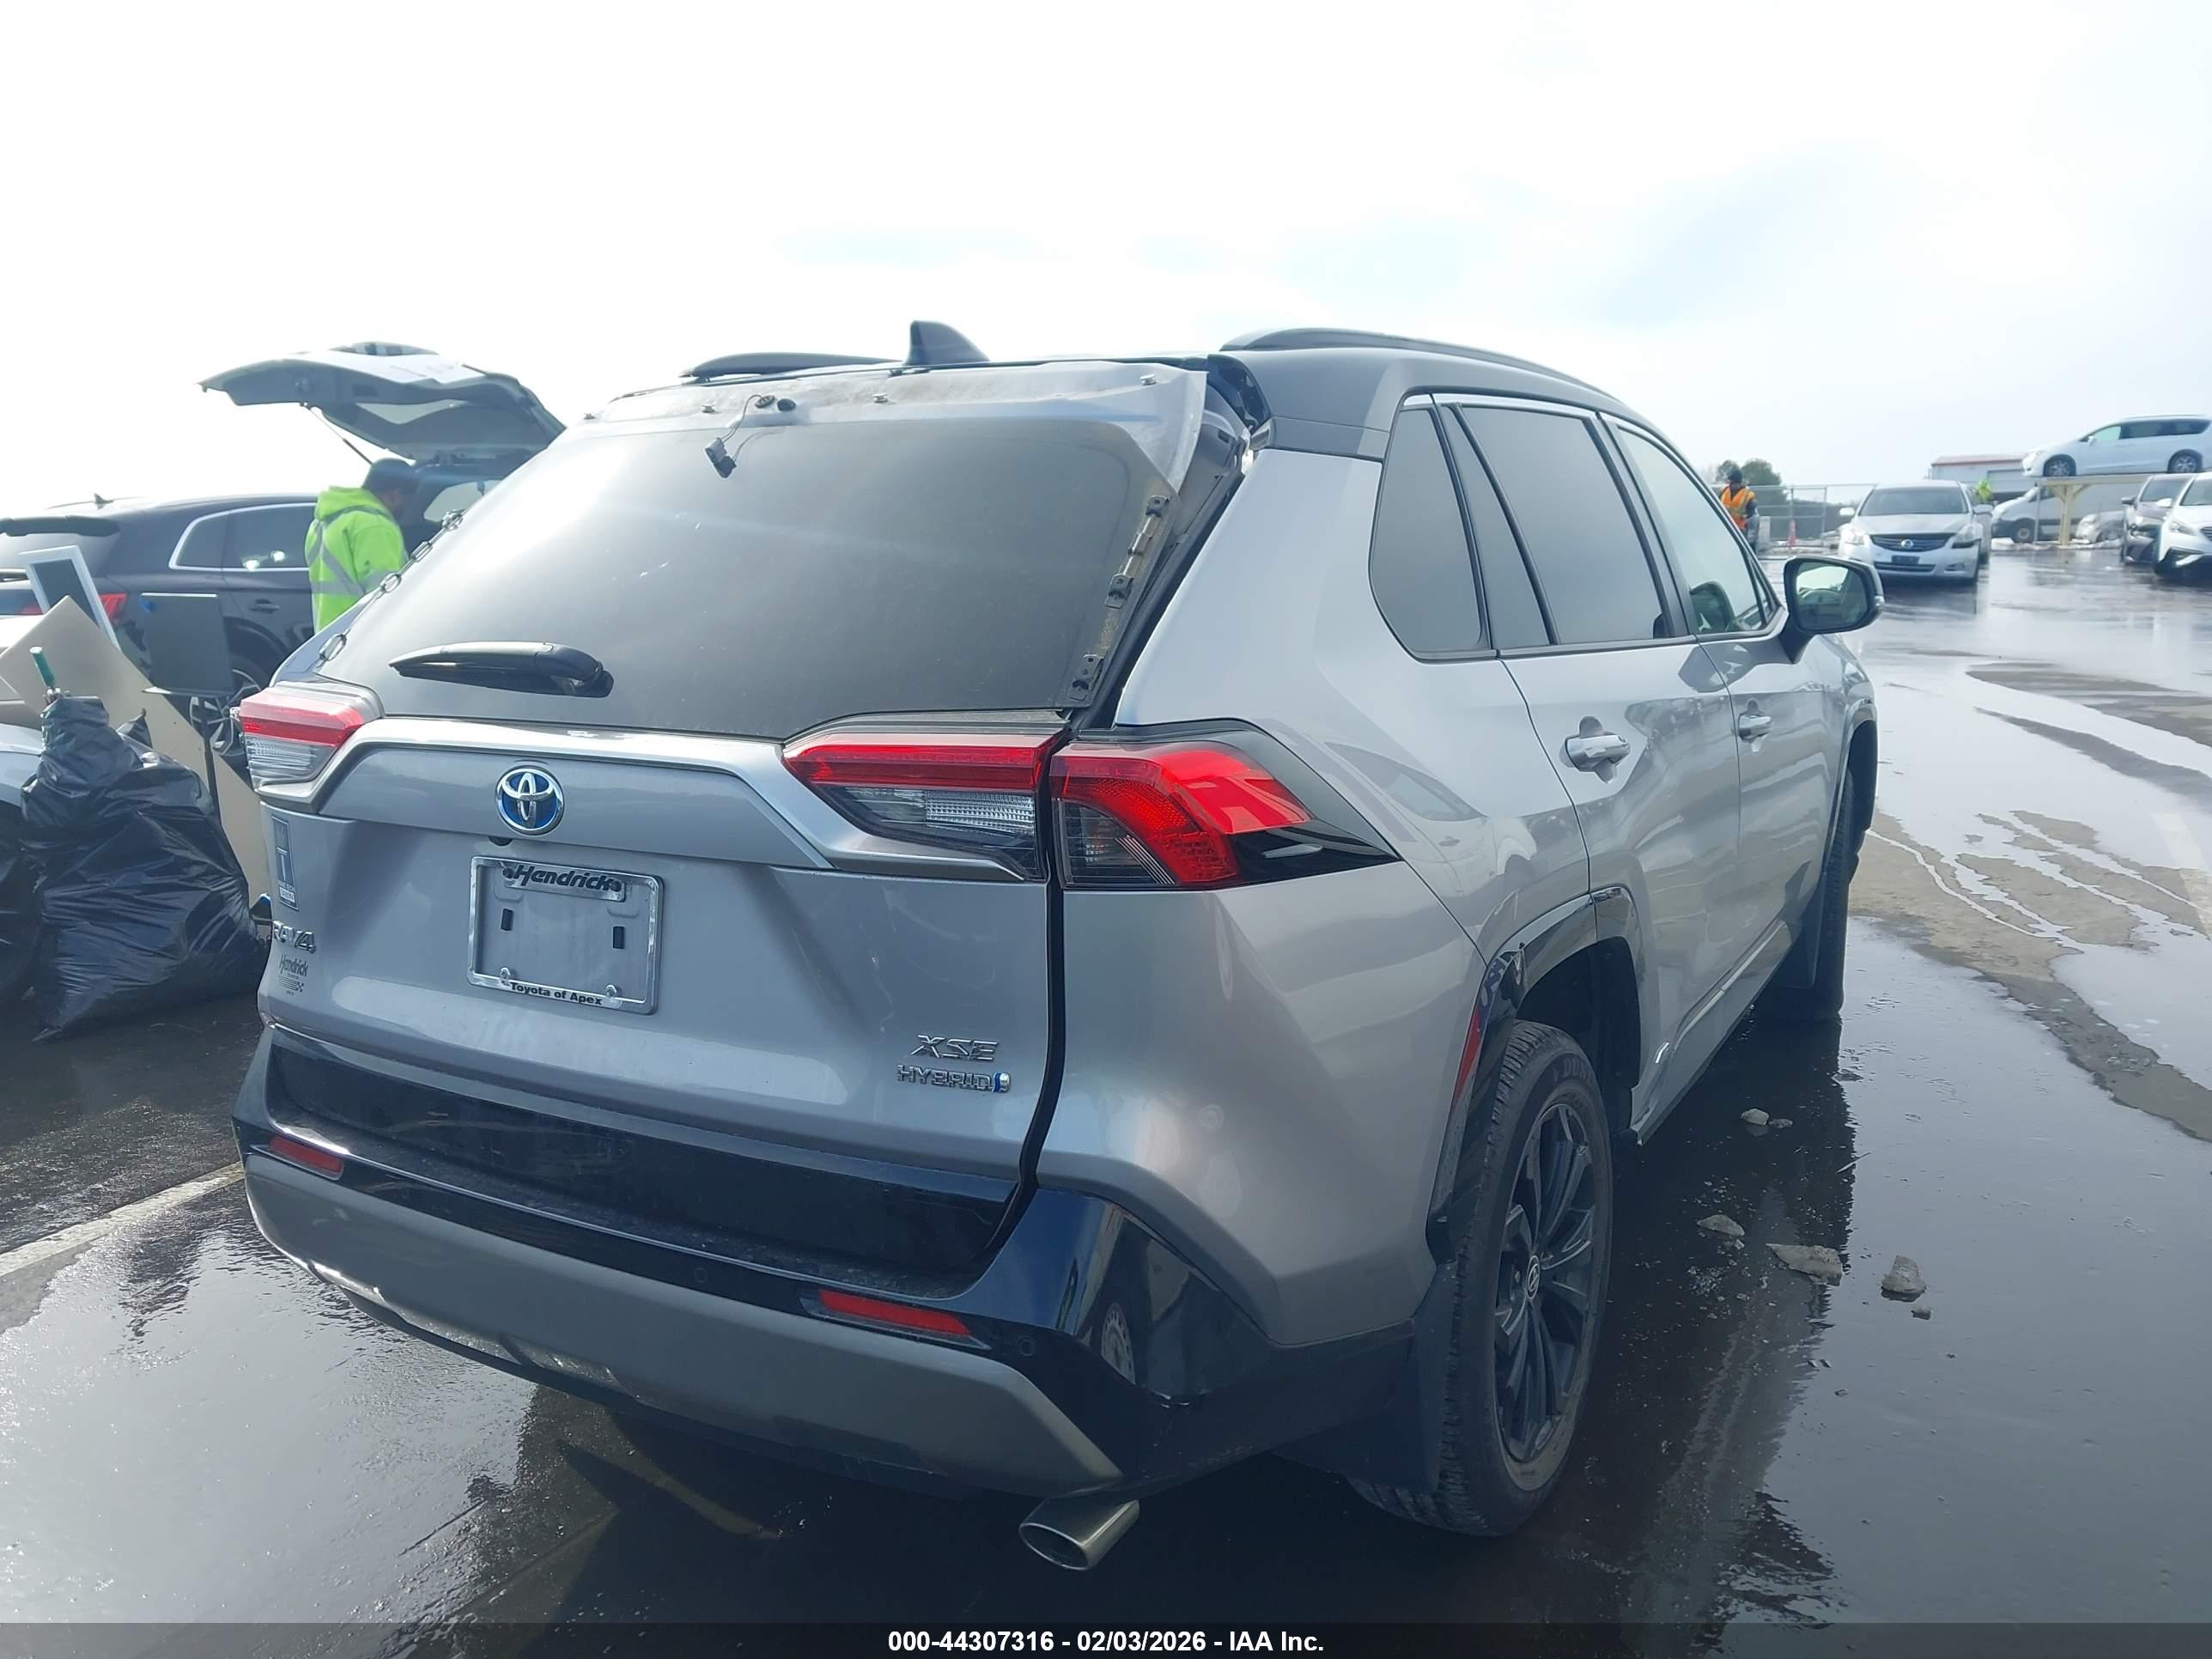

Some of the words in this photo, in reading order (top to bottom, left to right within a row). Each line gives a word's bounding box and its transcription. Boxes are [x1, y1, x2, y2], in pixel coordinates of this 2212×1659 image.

[514, 864, 611, 891] Hendrick
[273, 920, 316, 954] RAV4
[510, 982, 550, 997] Toyota
[554, 990, 567, 1000] of
[569, 993, 603, 1005] Apex
[910, 1034, 1000, 1061] XSE
[896, 1064, 993, 1091] HYBRID
